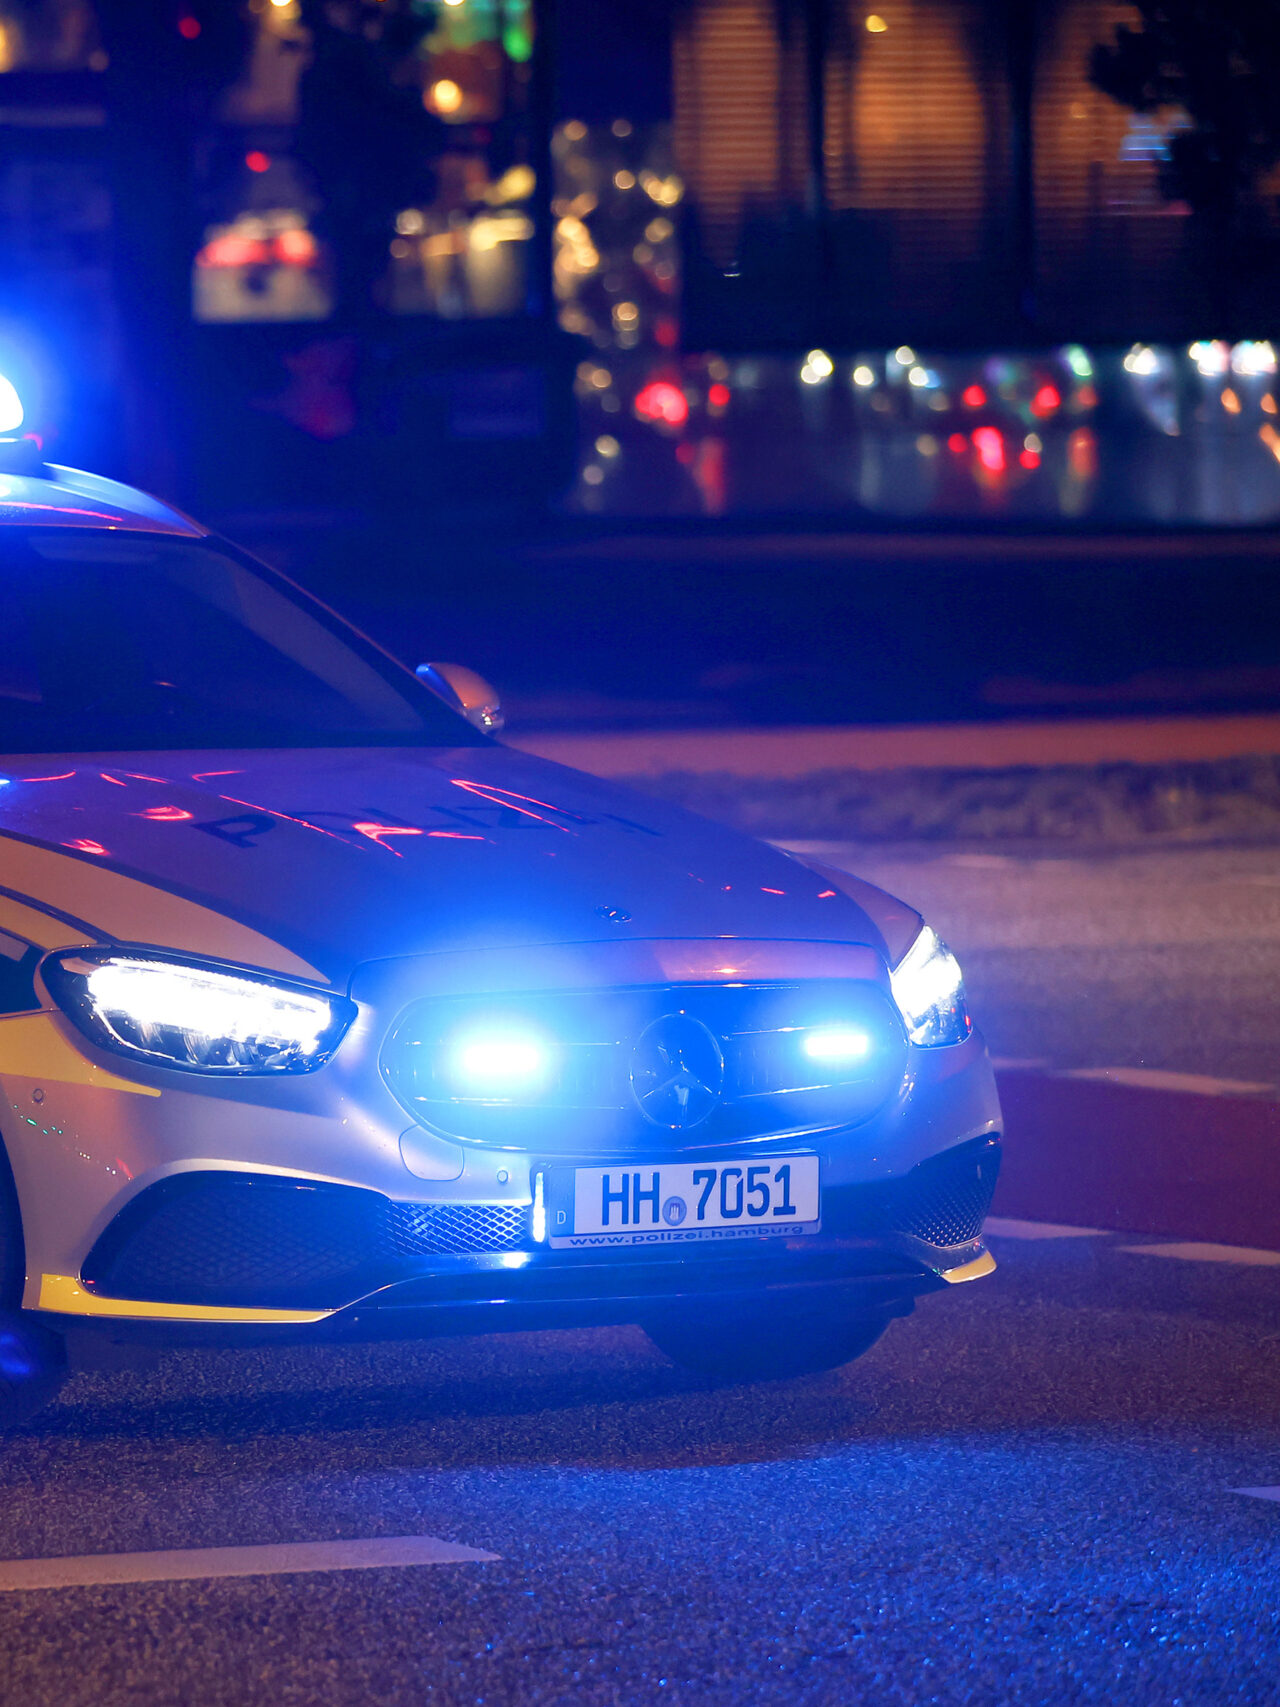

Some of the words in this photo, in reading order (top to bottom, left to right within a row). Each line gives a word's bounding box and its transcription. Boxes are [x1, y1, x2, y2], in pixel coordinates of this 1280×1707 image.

[601, 1172, 660, 1226] HH
[692, 1165, 797, 1221] 7051
[557, 1211, 567, 1225] D
[570, 1224, 804, 1246] www.polizei.hamburg
